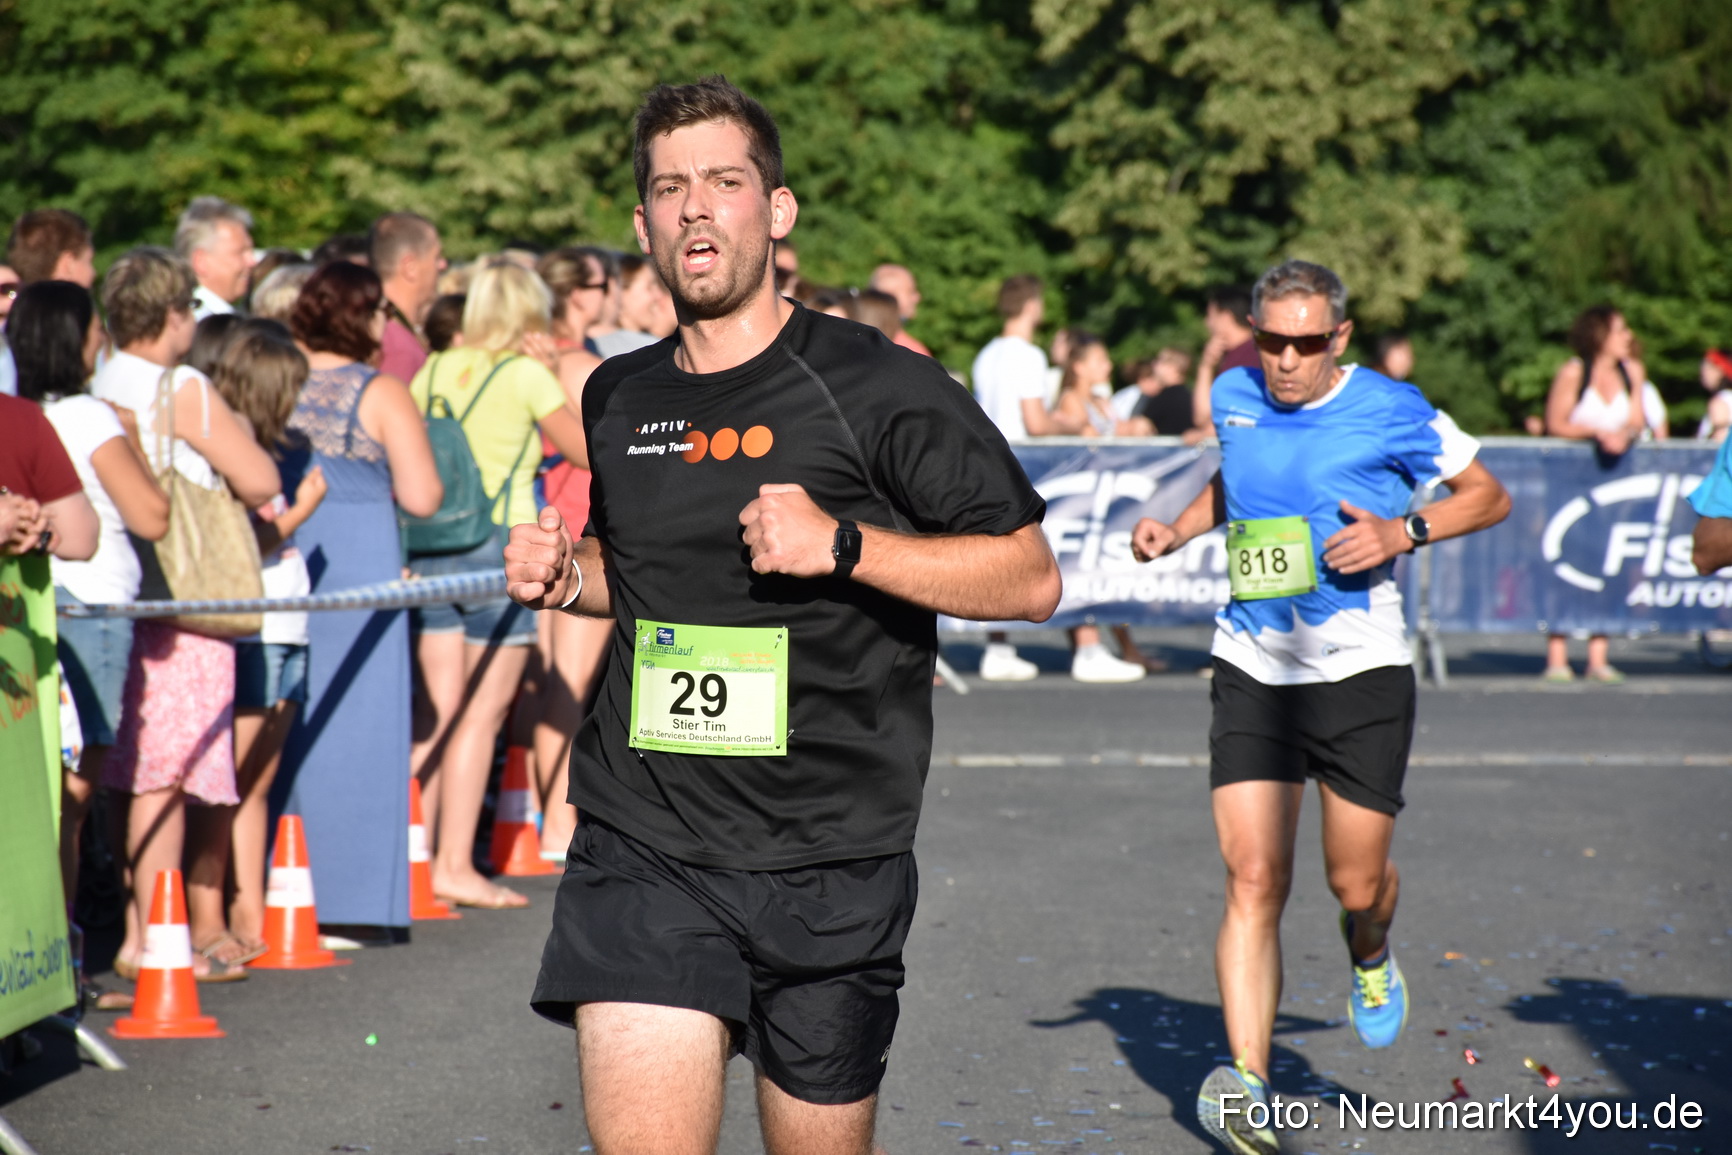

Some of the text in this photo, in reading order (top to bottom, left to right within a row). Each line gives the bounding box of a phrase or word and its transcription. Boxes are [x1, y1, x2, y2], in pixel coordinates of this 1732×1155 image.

[640, 420, 686, 435] APTIV
[627, 441, 694, 456] Running Team
[1239, 547, 1288, 576] 818
[1626, 580, 1732, 609] AUTO
[700, 656, 730, 667] 2018
[669, 671, 728, 718] 29
[672, 718, 727, 732] Stier Tim
[638, 727, 772, 743] Aptiv Services Deutschland GmbH
